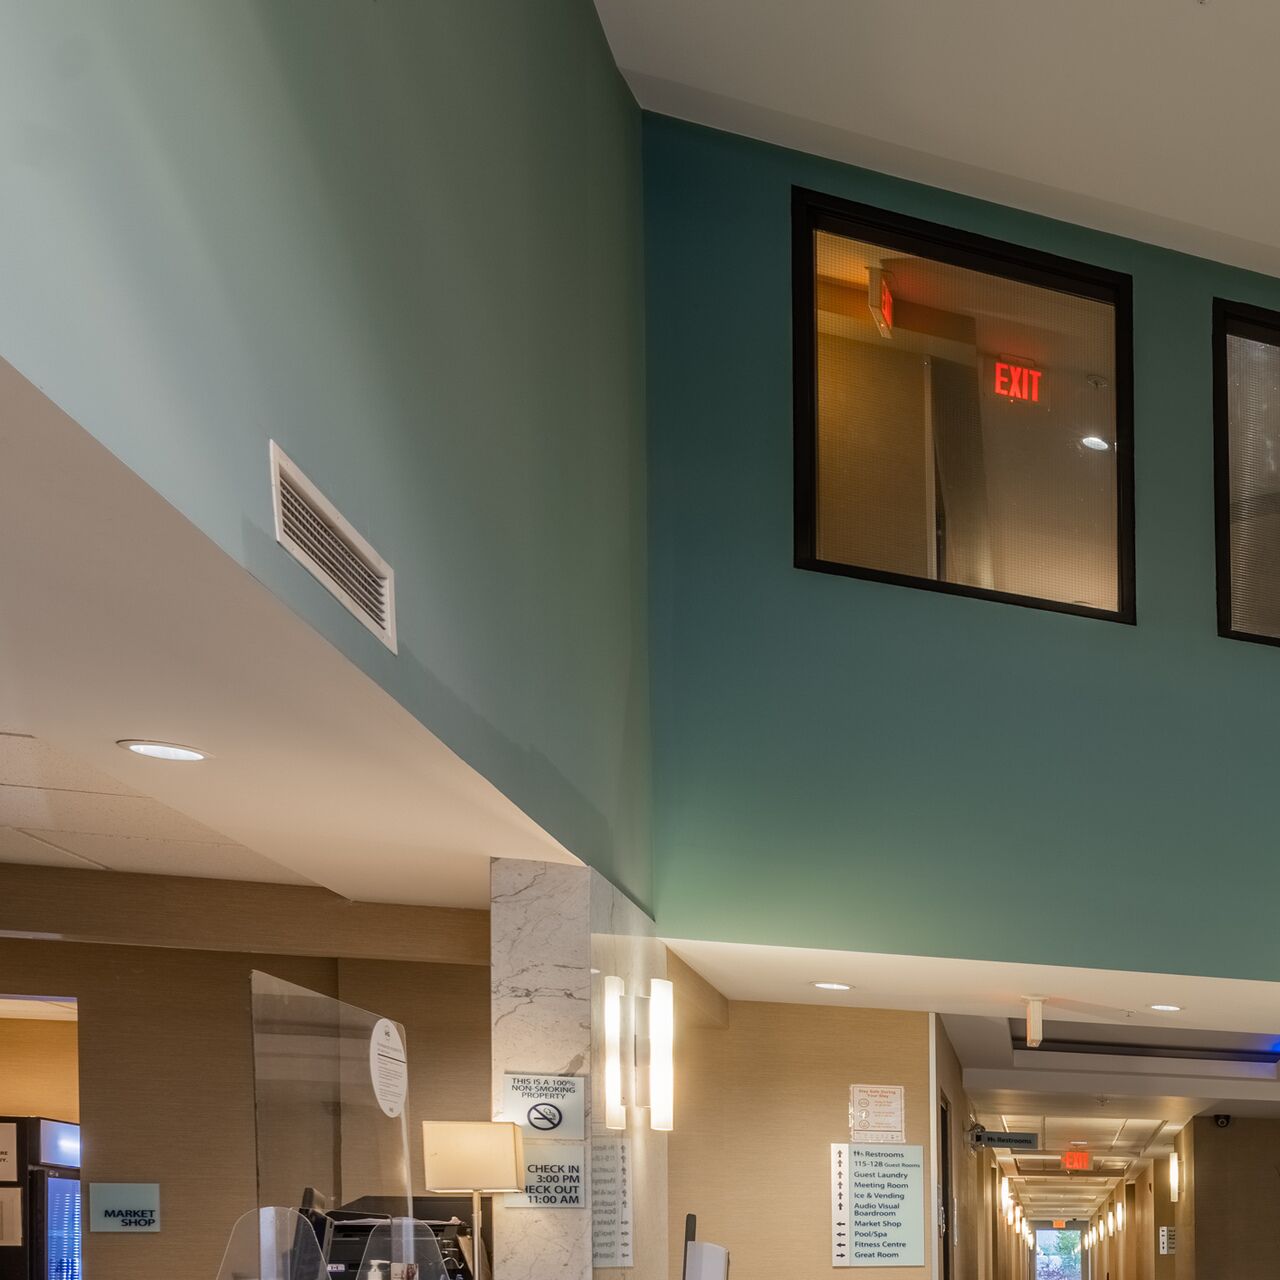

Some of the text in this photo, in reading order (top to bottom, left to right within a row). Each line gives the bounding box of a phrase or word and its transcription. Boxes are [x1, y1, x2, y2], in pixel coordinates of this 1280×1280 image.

[995, 362, 1042, 402] EXIT
[552, 1079, 575, 1087] 100%
[522, 1092, 566, 1100] PROPERTY
[999, 1137, 1032, 1145] Restrooms
[1066, 1152, 1089, 1170] EXIT
[527, 1164, 579, 1173] CHECK IN
[536, 1175, 580, 1183] 3:00 PM
[877, 1171, 908, 1180] Laundry
[854, 1181, 885, 1189] Meeting
[525, 1185, 579, 1194] ECK OUT
[528, 1195, 579, 1204] 11:00 AM
[874, 1192, 905, 1200] Vending
[104, 1210, 155, 1218] MARKET
[121, 1218, 156, 1227] SHOP
[883, 1220, 902, 1228] Shop
